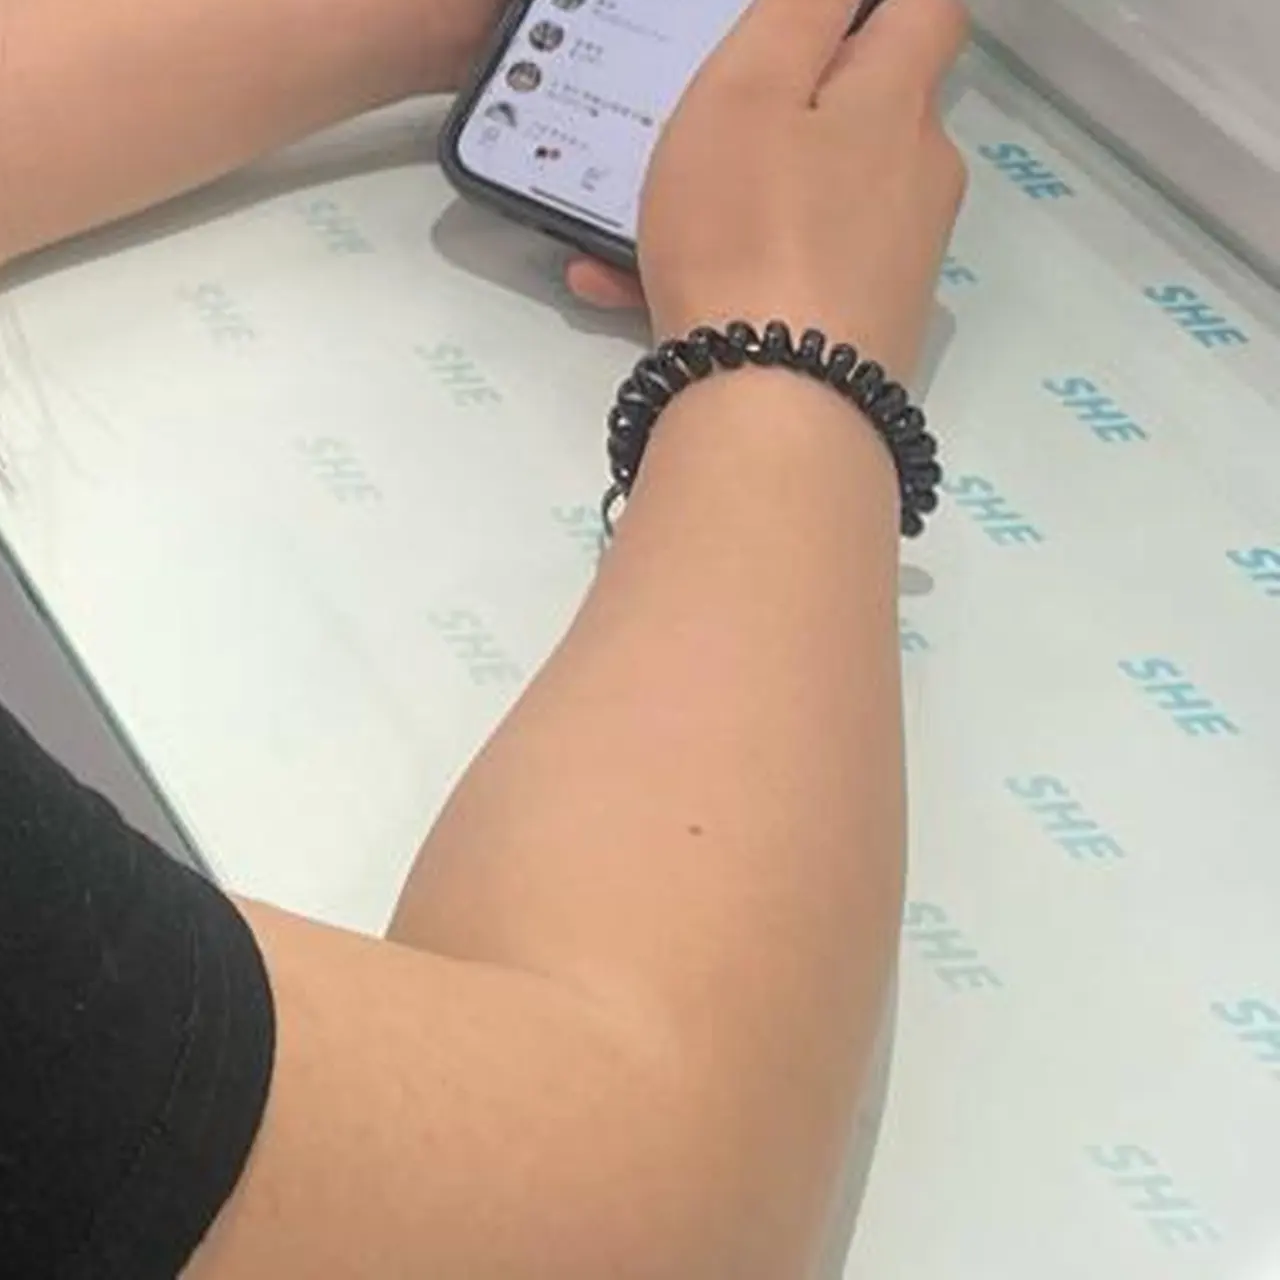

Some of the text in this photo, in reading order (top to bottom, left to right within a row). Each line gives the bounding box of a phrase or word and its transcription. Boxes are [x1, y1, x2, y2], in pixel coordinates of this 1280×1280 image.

[979, 142, 1076, 200] SHE
[1144, 284, 1250, 349] SHE
[1043, 375, 1149, 444] SHE
[941, 474, 1045, 547] SHE
[1119, 655, 1240, 738] SHE
[1003, 773, 1125, 864] SHE
[1081, 1144, 1223, 1248] SHE
